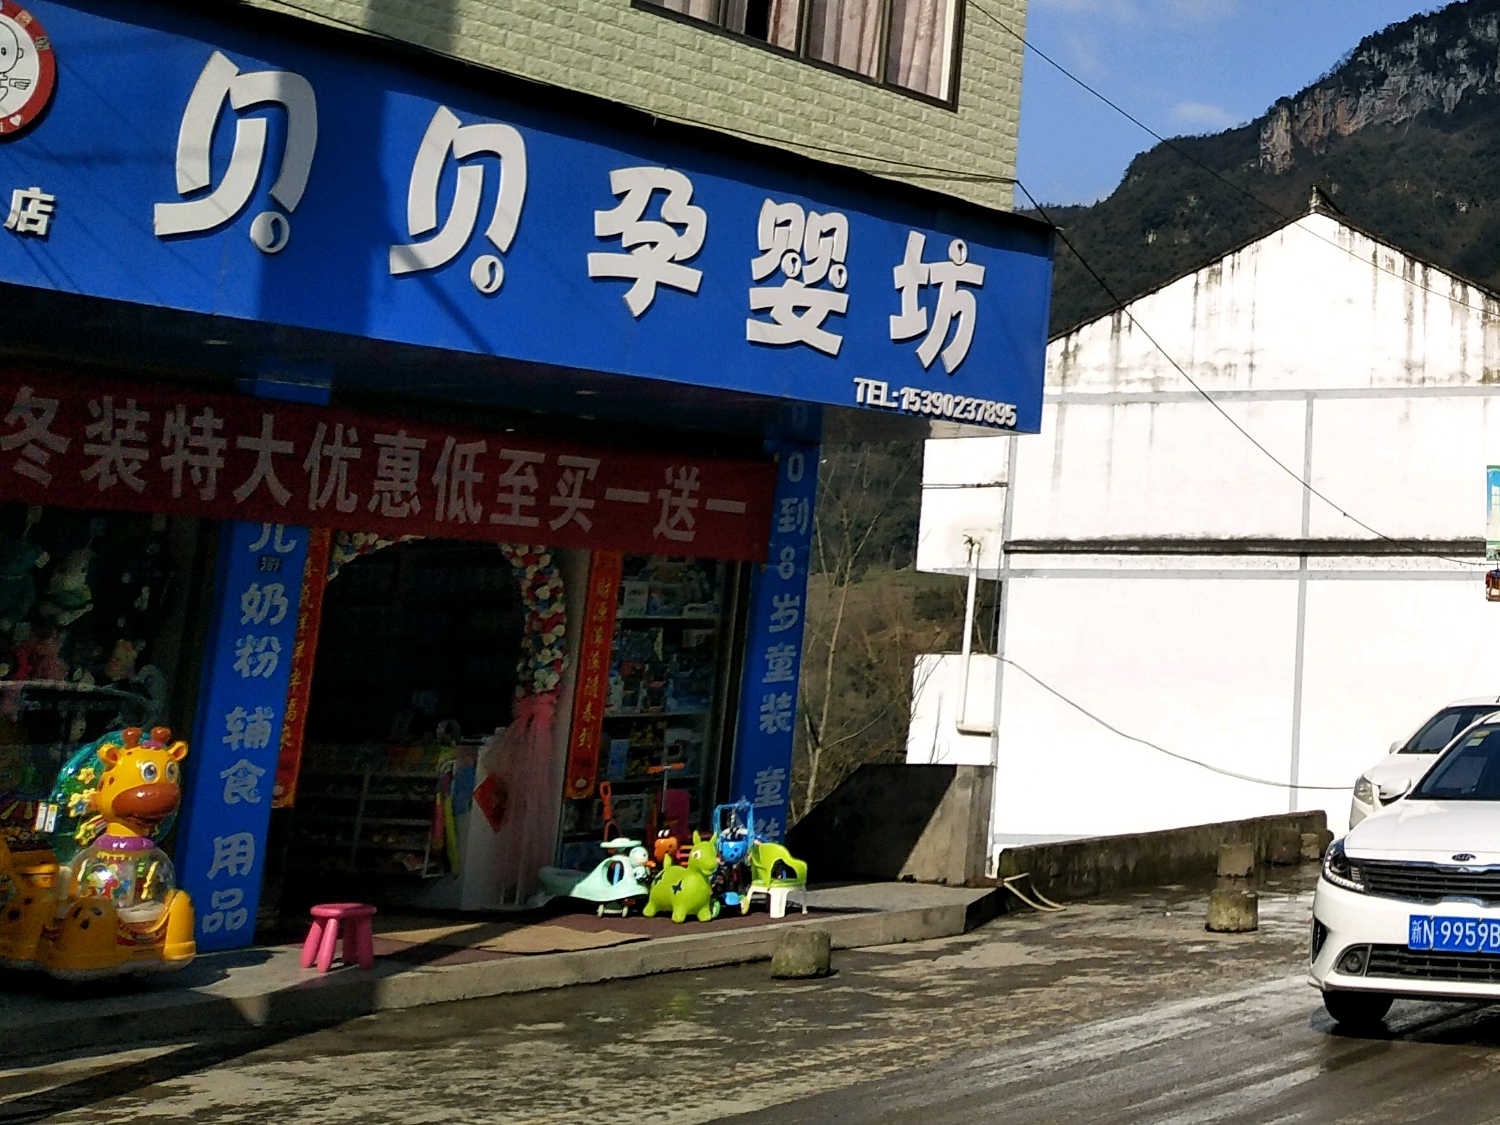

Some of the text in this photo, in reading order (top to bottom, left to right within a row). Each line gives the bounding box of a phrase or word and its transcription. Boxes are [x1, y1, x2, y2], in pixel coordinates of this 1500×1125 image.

[4, 186, 56, 236] 店
[153, 49, 986, 375] 贝贝孕婴坊
[0, 384, 747, 542] 冬装特大优惠低至买一送一
